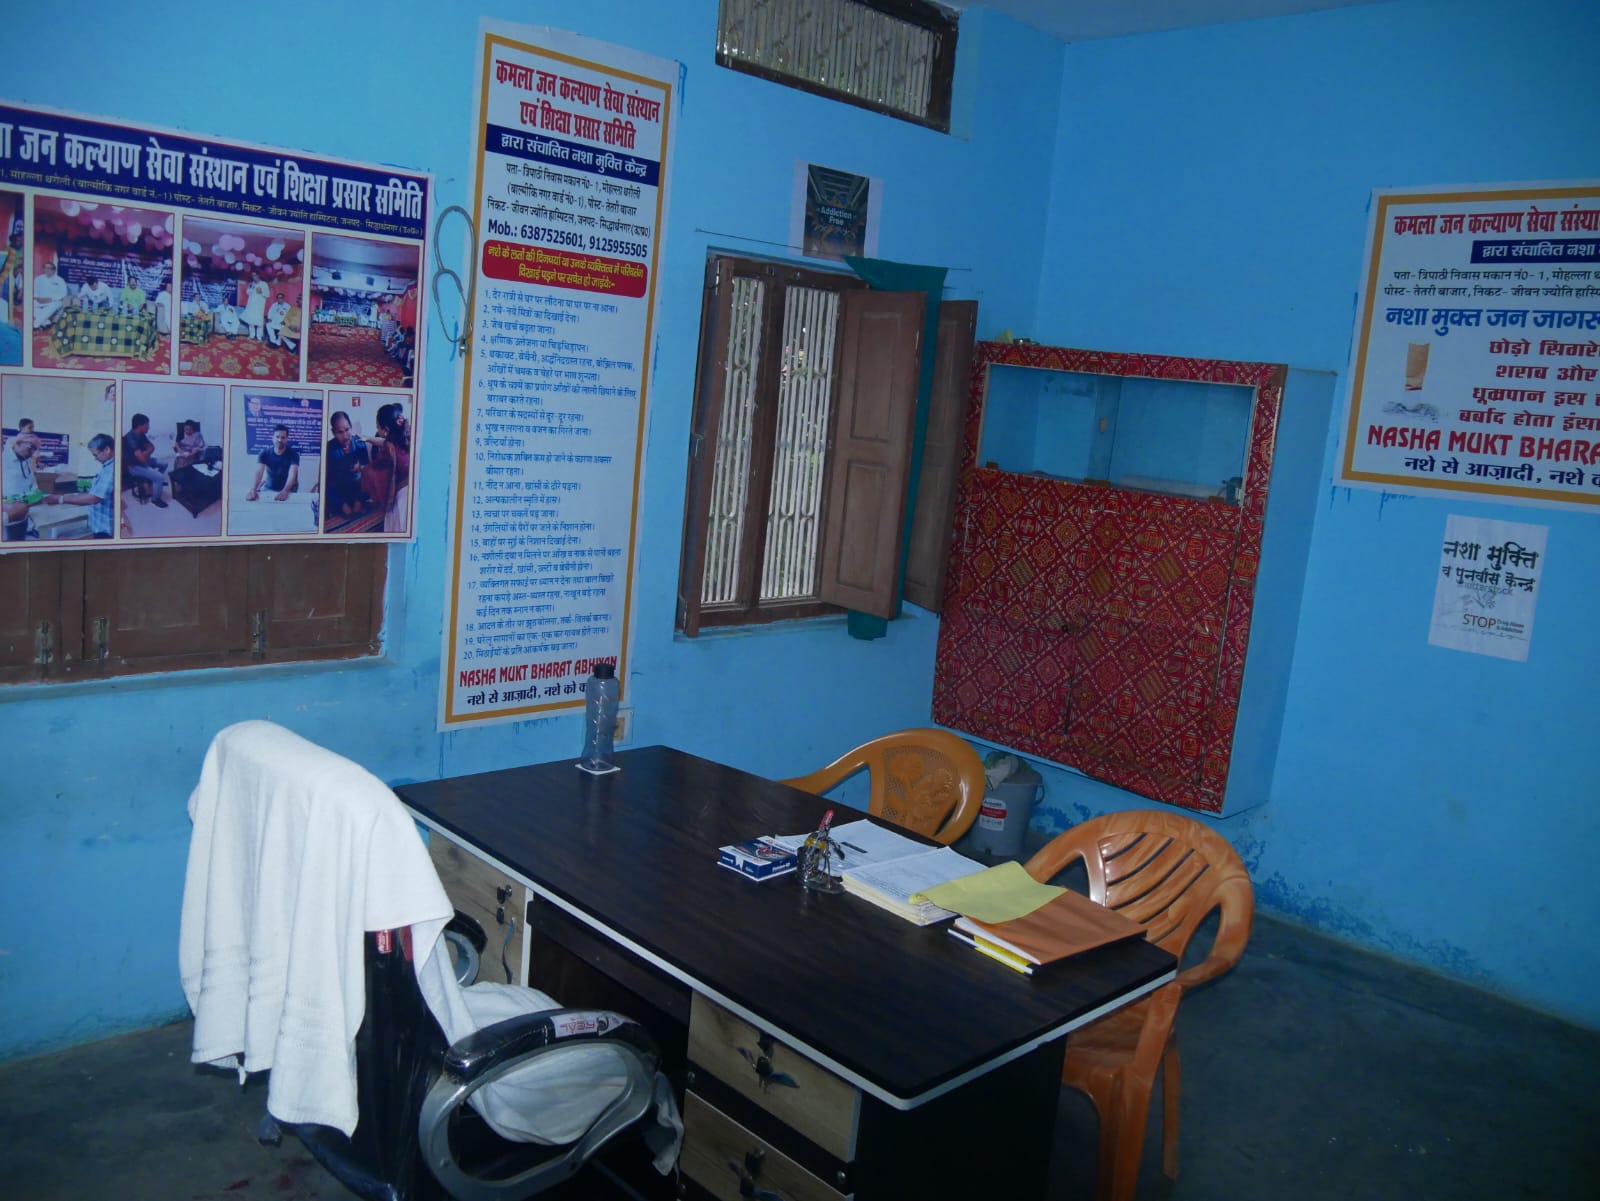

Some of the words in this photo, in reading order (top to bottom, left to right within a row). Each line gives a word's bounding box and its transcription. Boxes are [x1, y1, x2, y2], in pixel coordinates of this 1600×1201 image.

[495, 59, 534, 91] कमला
[535, 70, 557, 96] जन
[559, 76, 601, 108] कल्याण
[603, 81, 625, 113] सेवा
[626, 88, 661, 122] संस्थान
[519, 93, 539, 127] एवं
[540, 98, 572, 134] शिक्षा
[573, 114, 601, 141] प्रसार
[602, 114, 636, 149] समिति
[501, 133, 523, 150] द्वारा
[526, 134, 569, 159] संचालित
[572, 149, 593, 164] नशा
[595, 150, 622, 175] मुक्ति
[624, 159, 647, 177] केन्द्र
[19, 125, 58, 165] जन
[64, 132, 141, 177] कल्याण
[146, 135, 185, 184] सेवा
[189, 145, 249, 194] संस्थान
[252, 155, 280, 198] एवं
[283, 160, 328, 205] शिक्षा
[331, 177, 372, 213] प्रसार
[375, 176, 423, 219] समिति
[1394, 215, 1437, 235] कमला
[1440, 214, 1465, 234] जन
[1468, 212, 1525, 233] कल्याण
[1527, 205, 1558, 232] सेवा
[521, 223, 586, 250] 6387525601,
[589, 235, 647, 257] 9125955505
[1482, 245, 1508, 257] द्वारा
[1512, 242, 1564, 256] संचालित
[1566, 244, 1596, 256] नशा
[1394, 271, 1415, 280] पता-
[1418, 268, 1448, 280] त्रिपाठी
[1450, 268, 1480, 280] निवास
[1483, 271, 1512, 280] मकान
[1552, 267, 1592, 281] मोहल्ला
[1386, 308, 1429, 325] नशा
[1432, 308, 1483, 336] मुक्त
[1486, 309, 1530, 328] जन
[1489, 338, 1532, 357] छोड़ो
[1540, 340, 1600, 357] सिगरे
[1496, 365, 1550, 379] शराब
[1557, 364, 1598, 381] और
[1554, 392, 1587, 406] इस
[1459, 407, 1507, 424] बर्बाद
[1514, 410, 1556, 428] होता
[1368, 425, 1440, 451] NASHA
[1448, 431, 1512, 457] MUKT
[1404, 456, 1436, 474] नशे
[1442, 456, 1459, 474] से
[1550, 468, 1585, 486] नशे
[1444, 540, 1481, 561] नशा
[1487, 541, 1540, 570] मुक्ति
[1442, 566, 1452, 578] व
[1456, 567, 1501, 586] पुनर्वास
[1505, 572, 1536, 592] केन्द्र
[1462, 614, 1497, 628] STOP
[459, 667, 496, 687] NASHA
[500, 664, 528, 682] MUKT
[530, 660, 572, 679] BHARAT
[466, 691, 485, 706] नशे
[488, 689, 498, 704] से
[544, 683, 560, 696] नशे
[564, 681, 576, 694] को
